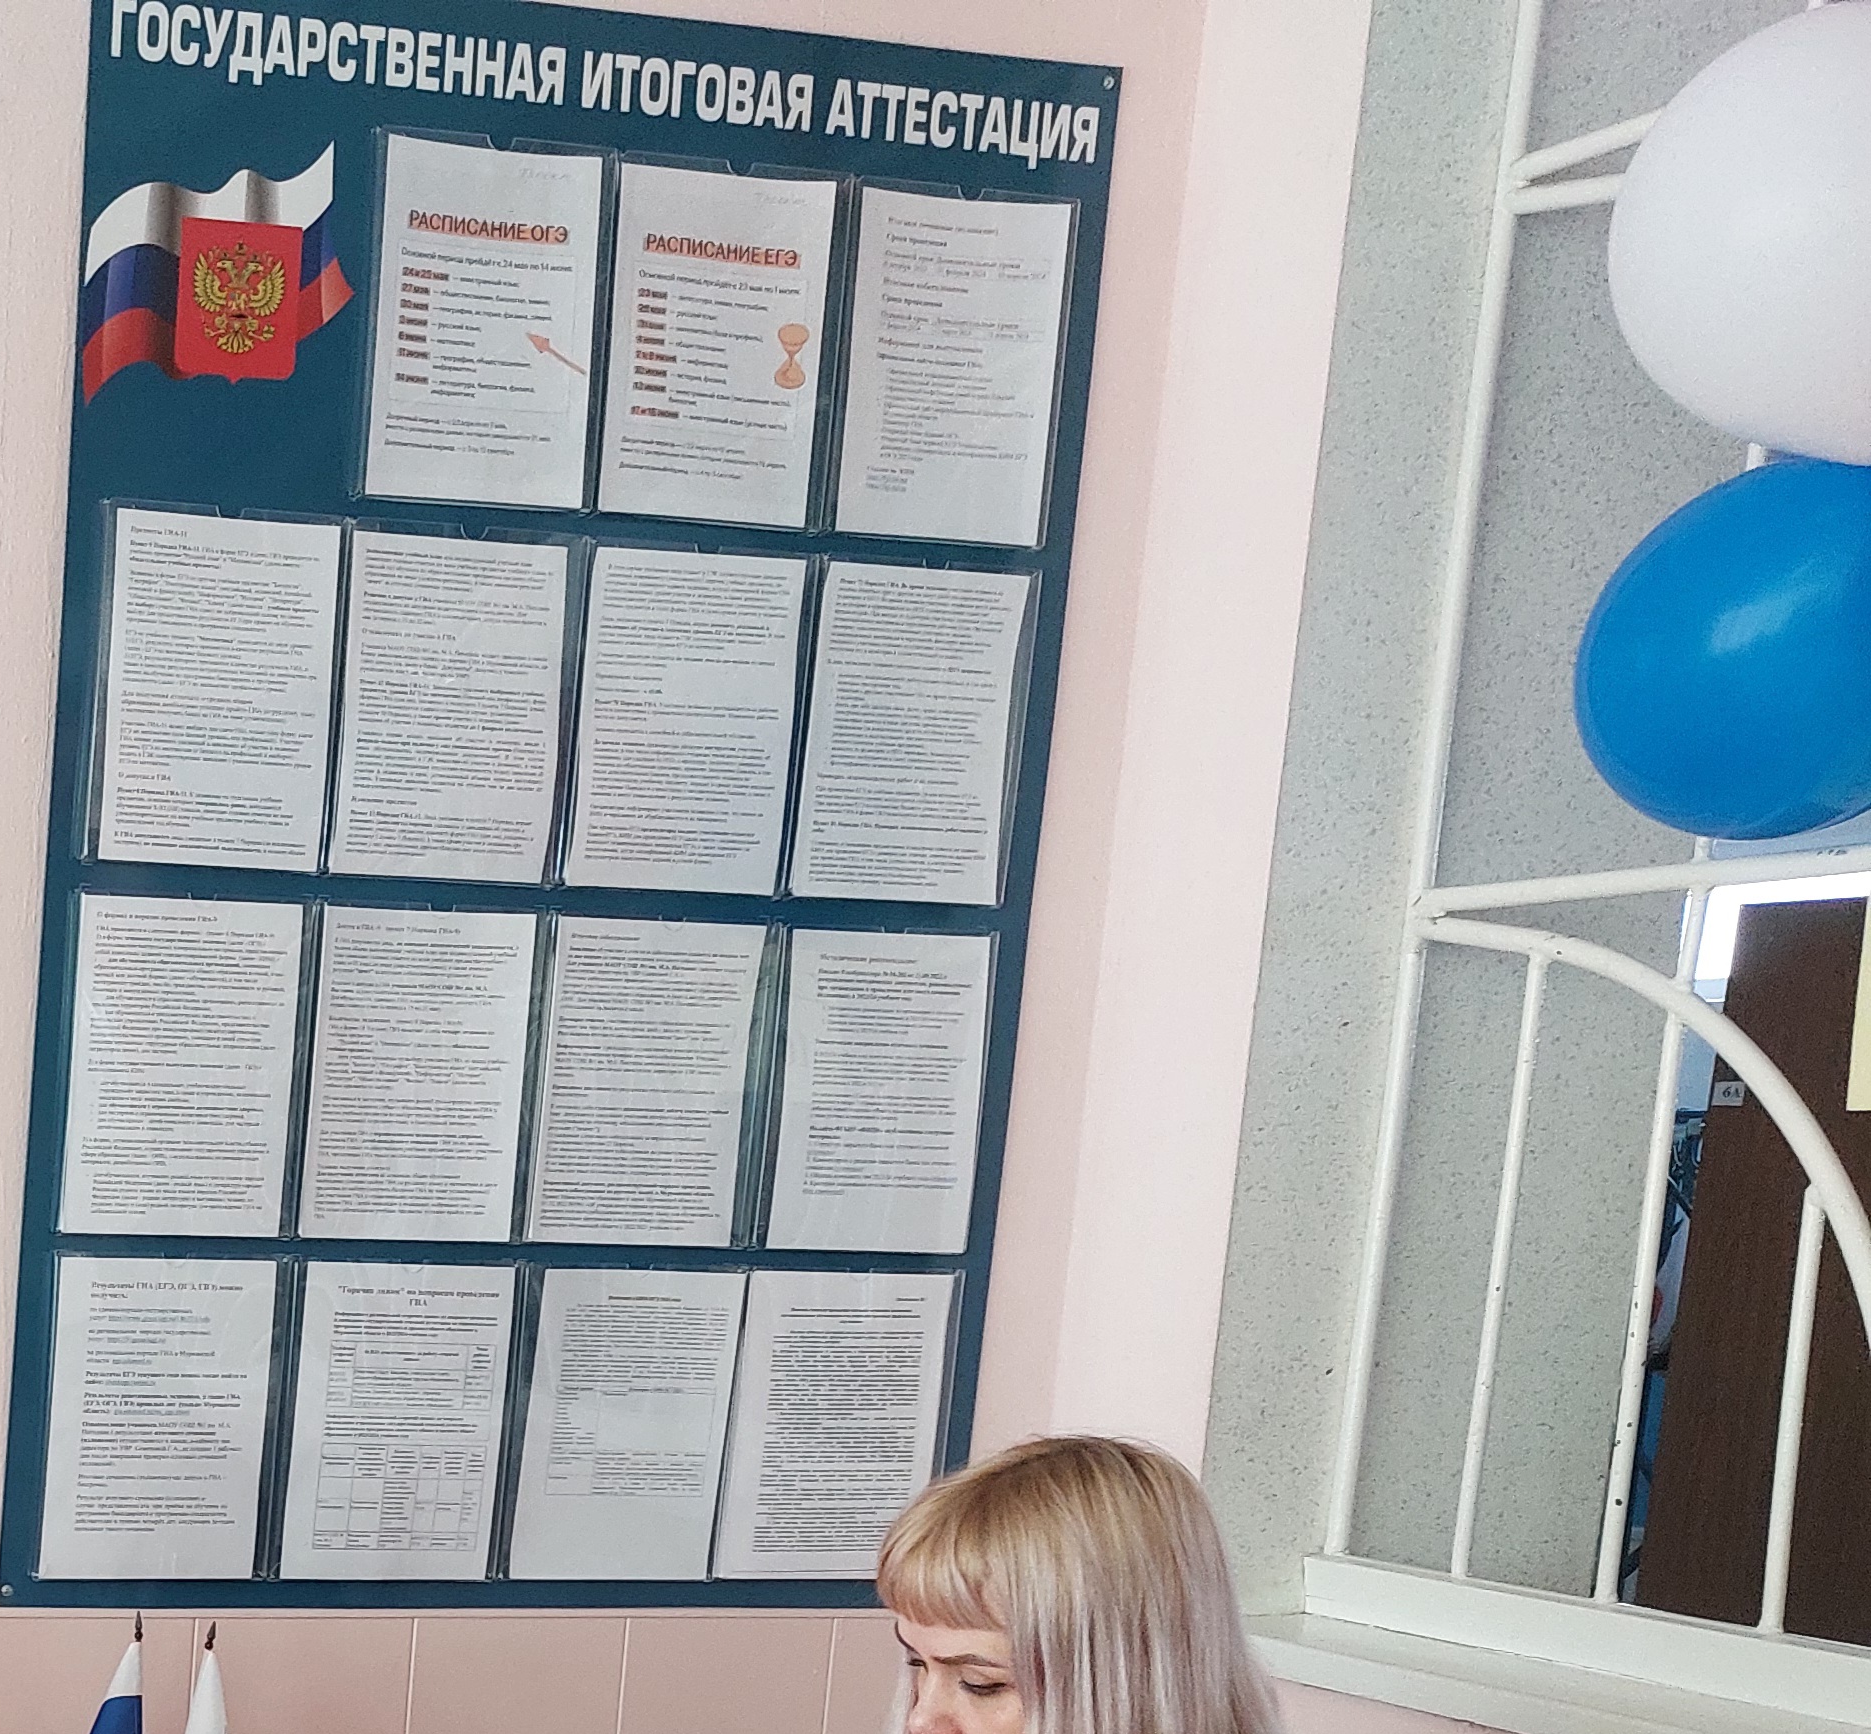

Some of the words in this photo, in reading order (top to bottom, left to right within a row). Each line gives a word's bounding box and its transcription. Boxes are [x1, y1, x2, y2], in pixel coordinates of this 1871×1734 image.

[110, 0, 567, 106] ГОСУДАРСТВЕННАЯ
[581, 50, 814, 133] ИТОГОВАЯ
[826, 79, 1100, 169] АТТЕСТАЦИЯ
[409, 209, 528, 240] РАСПИСАНИЕ
[531, 224, 569, 244] ОГЭ
[647, 233, 762, 264] РАСПИСАНИЕ
[764, 249, 797, 266] ЕГЭ
